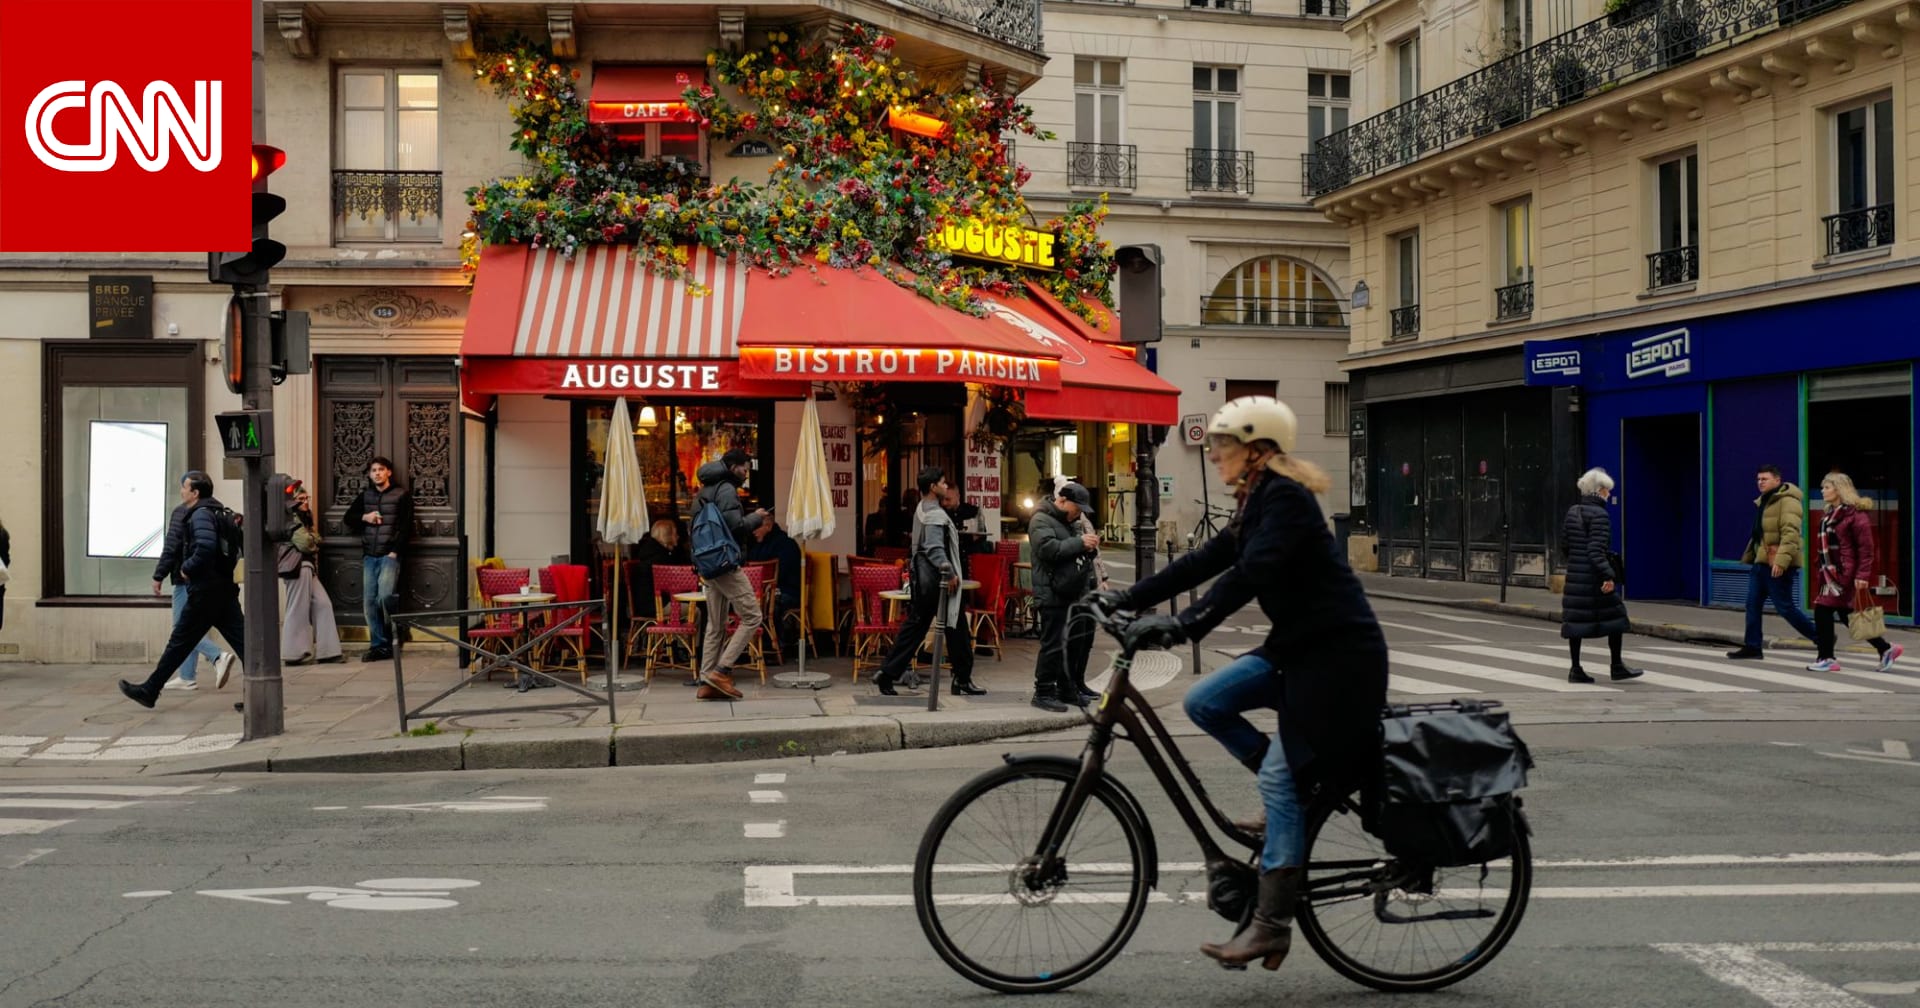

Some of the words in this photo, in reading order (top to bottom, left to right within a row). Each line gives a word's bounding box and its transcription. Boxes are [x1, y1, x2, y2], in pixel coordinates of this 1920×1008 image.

[623, 104, 669, 117] CAFE
[95, 285, 130, 295] BRED
[95, 295, 145, 306] BANQUE
[1632, 338, 1684, 368] ESPOT
[775, 349, 922, 373] BISTROT
[936, 350, 1041, 381] PARISIEN
[1536, 355, 1576, 369] ESPOT
[560, 364, 719, 390] AUGUSTE
[1193, 429, 1201, 437] 30
[831, 488, 849, 508] TAILS
